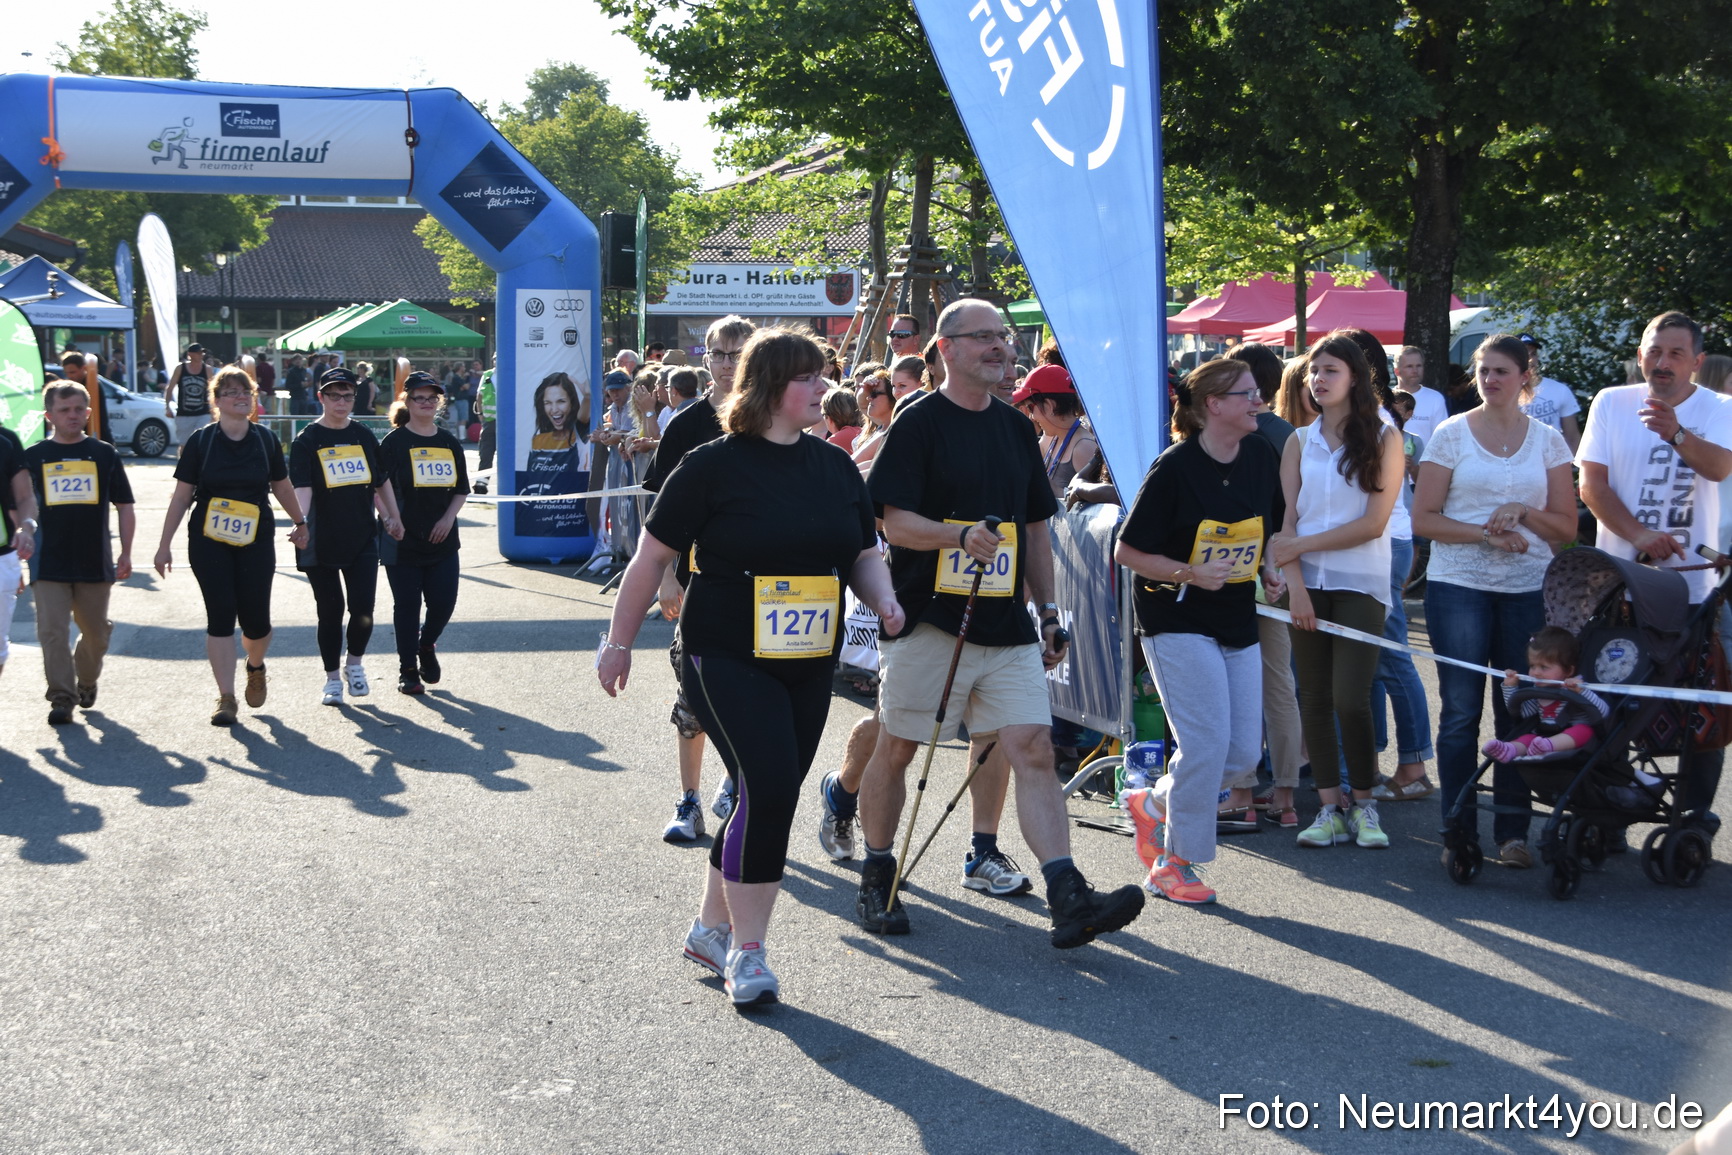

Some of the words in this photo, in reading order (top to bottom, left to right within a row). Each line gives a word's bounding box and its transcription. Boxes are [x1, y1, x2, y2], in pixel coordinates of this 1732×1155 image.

[233, 116, 277, 126] Fischer
[200, 138, 331, 164] firmenlauf
[200, 162, 254, 171] neumarkt
[484, 186, 502, 196] das
[502, 186, 537, 196] Lächeln
[487, 198, 512, 209] fährt
[683, 270, 727, 285] Jura
[328, 460, 365, 475] 1194
[418, 463, 452, 476] 1193
[535, 462, 568, 472] Fischer
[51, 478, 91, 492] 1221
[1635, 444, 1674, 530] BFLD
[212, 515, 251, 535] 1191
[1201, 545, 1256, 566] 1275
[766, 609, 829, 635] 1271
